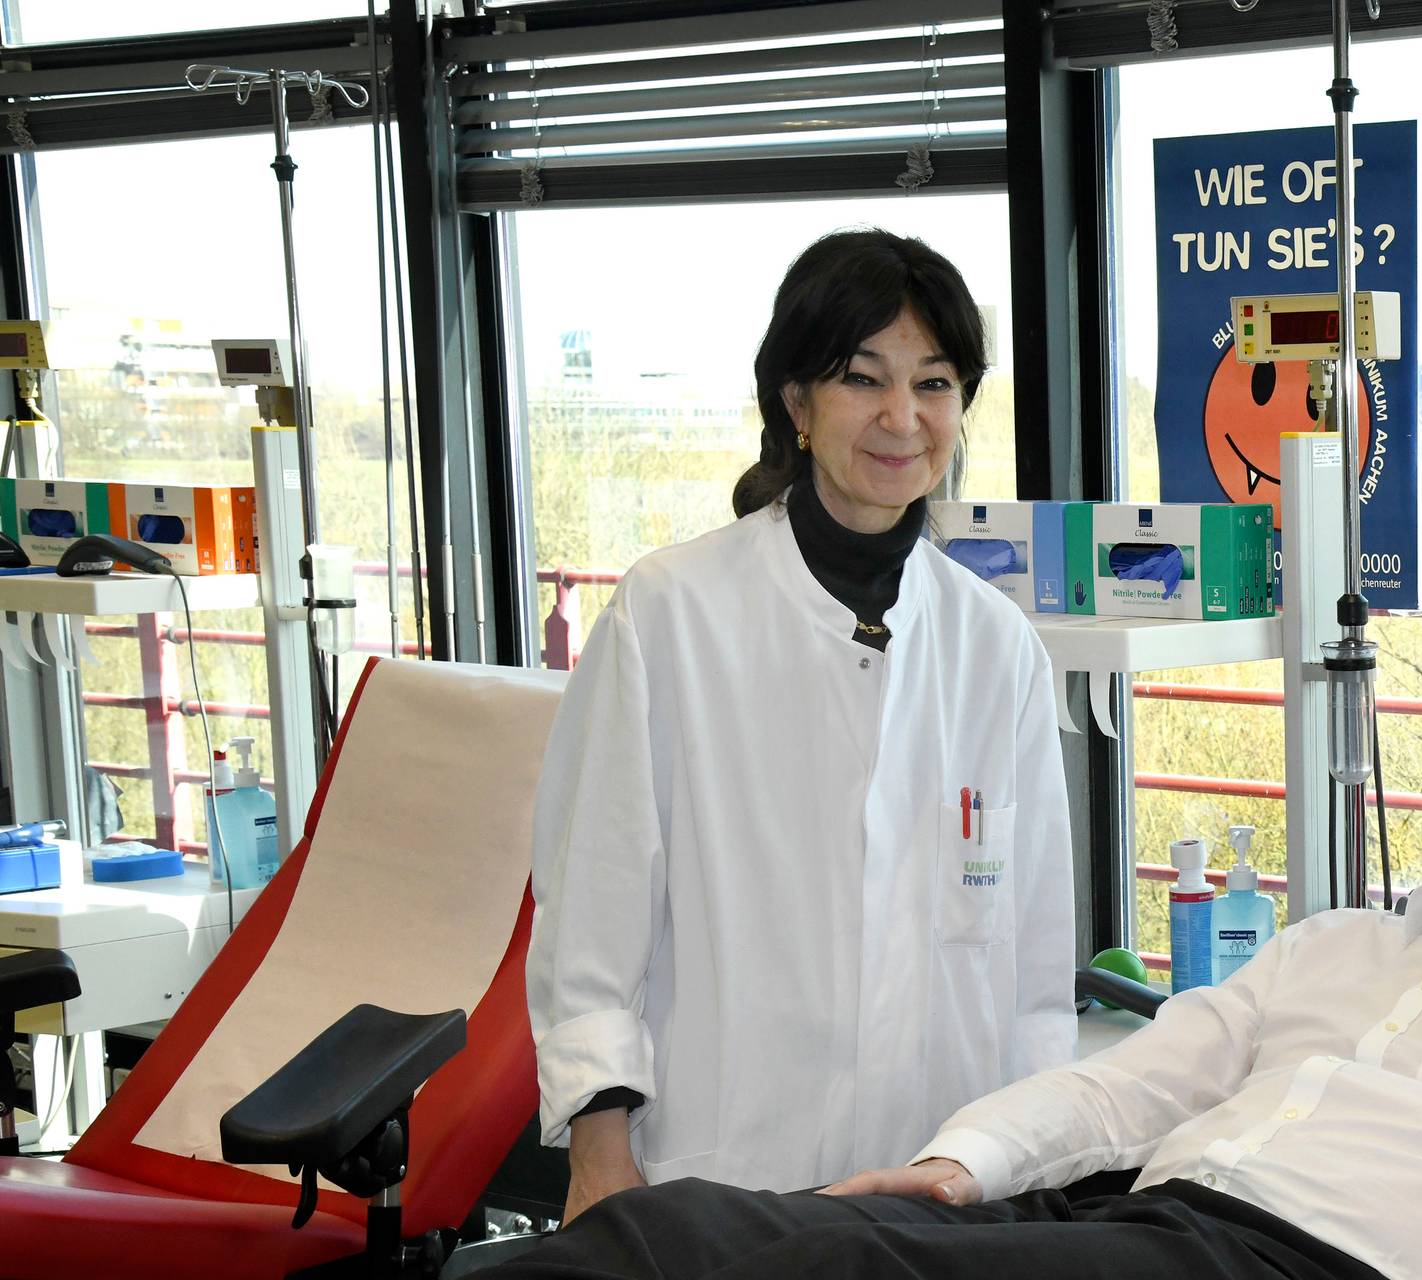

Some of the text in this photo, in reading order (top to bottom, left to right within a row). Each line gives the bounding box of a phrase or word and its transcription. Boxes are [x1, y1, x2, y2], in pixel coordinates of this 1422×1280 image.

[1194, 164, 1267, 207] WIE
[1172, 231, 1250, 273] TUN
[1359, 428, 1388, 505] AACHEN
[968, 525, 992, 534] Classic
[1134, 529, 1159, 538] Classic
[1112, 589, 1134, 598] Nitrile
[1213, 588, 1219, 598] S
[963, 874, 995, 886] RWTH
